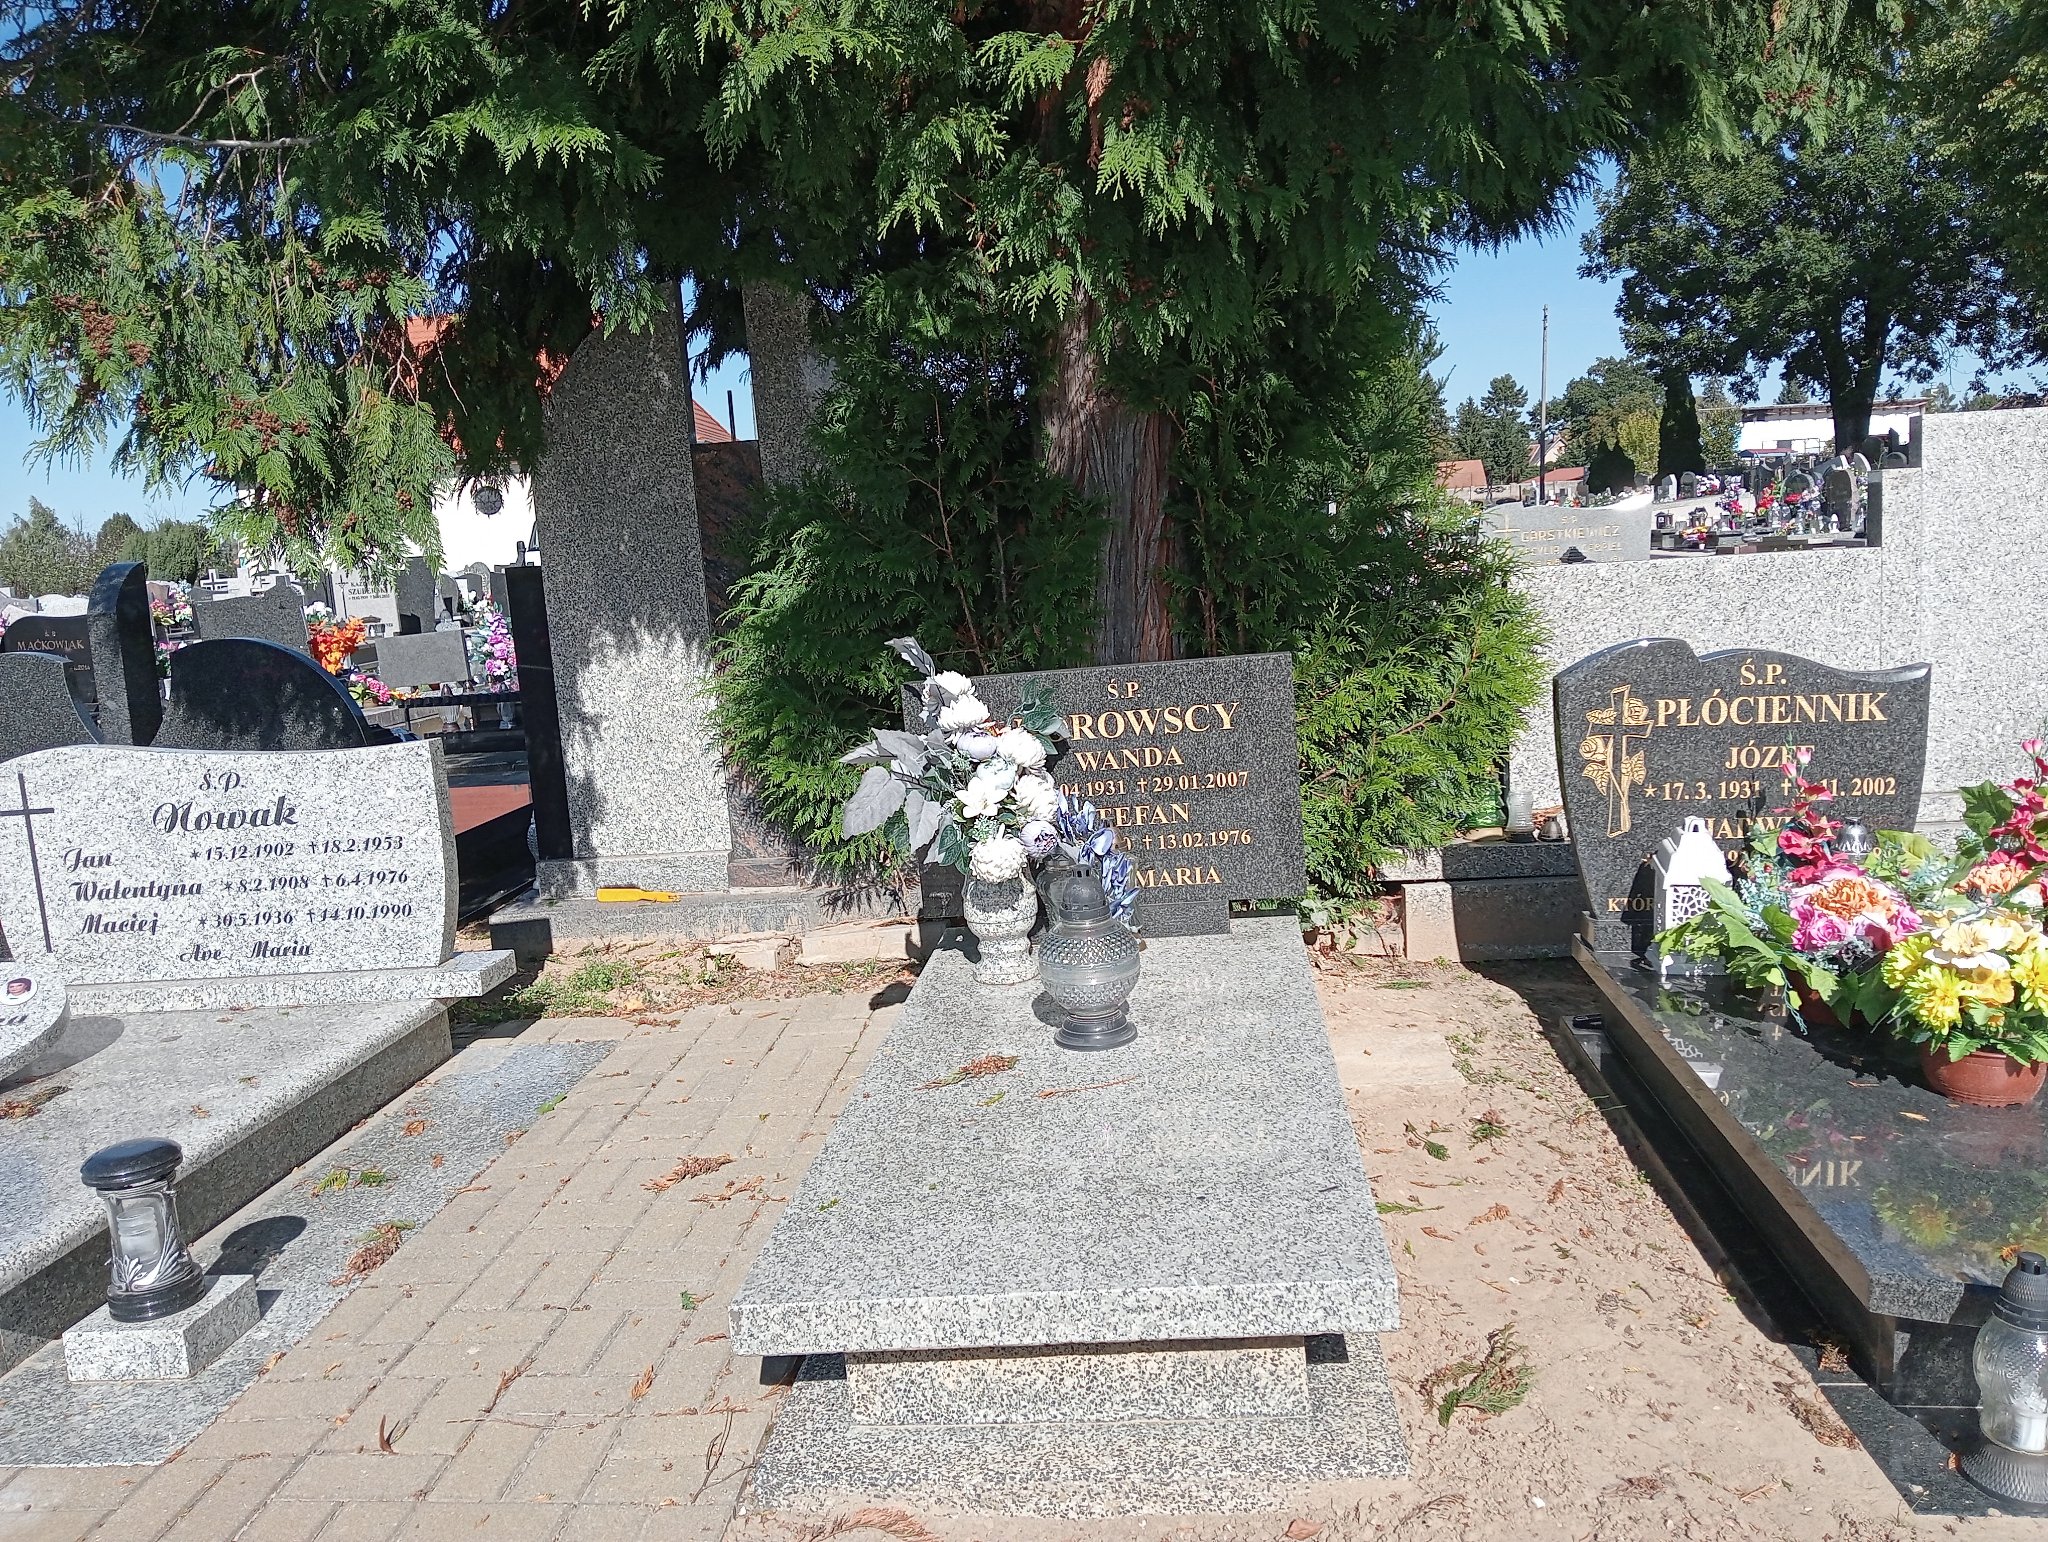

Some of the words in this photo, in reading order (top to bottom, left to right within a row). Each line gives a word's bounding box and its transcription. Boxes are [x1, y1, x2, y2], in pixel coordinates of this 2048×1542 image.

[17, 639, 85, 651] MAĆKOWIAK
[1740, 658, 1787, 686] Ś.P.
[1107, 678, 1142, 700] Ś.P.
[1655, 688, 1888, 727] PŁÓCIENNIK
[1074, 746, 1185, 773] WANDA
[199, 769, 247, 793] Ś.P.
[1152, 771, 1249, 793] 29.01.2007
[1662, 781, 1690, 801] 17.
[1694, 780, 1712, 800] 3.
[1718, 779, 1761, 799] 1931
[1851, 776, 1897, 796] 2002
[152, 794, 299, 833] Nowak
[1096, 802, 1191, 827] TEFAN
[1157, 828, 1252, 850] 13.02.1976
[63, 847, 113, 873] Jan
[205, 842, 295, 861] 15.12.1902
[322, 835, 404, 854] 18.2.1953
[69, 880, 202, 902] Walentyna
[238, 874, 310, 893] 8.2.1908
[335, 868, 408, 888] 6.4.1976
[1134, 865, 1223, 888] MARIA
[80, 912, 160, 936] Maciej
[212, 909, 294, 928] 30.5.1936
[319, 903, 413, 923] 14.10.1990
[179, 943, 230, 963] Ave
